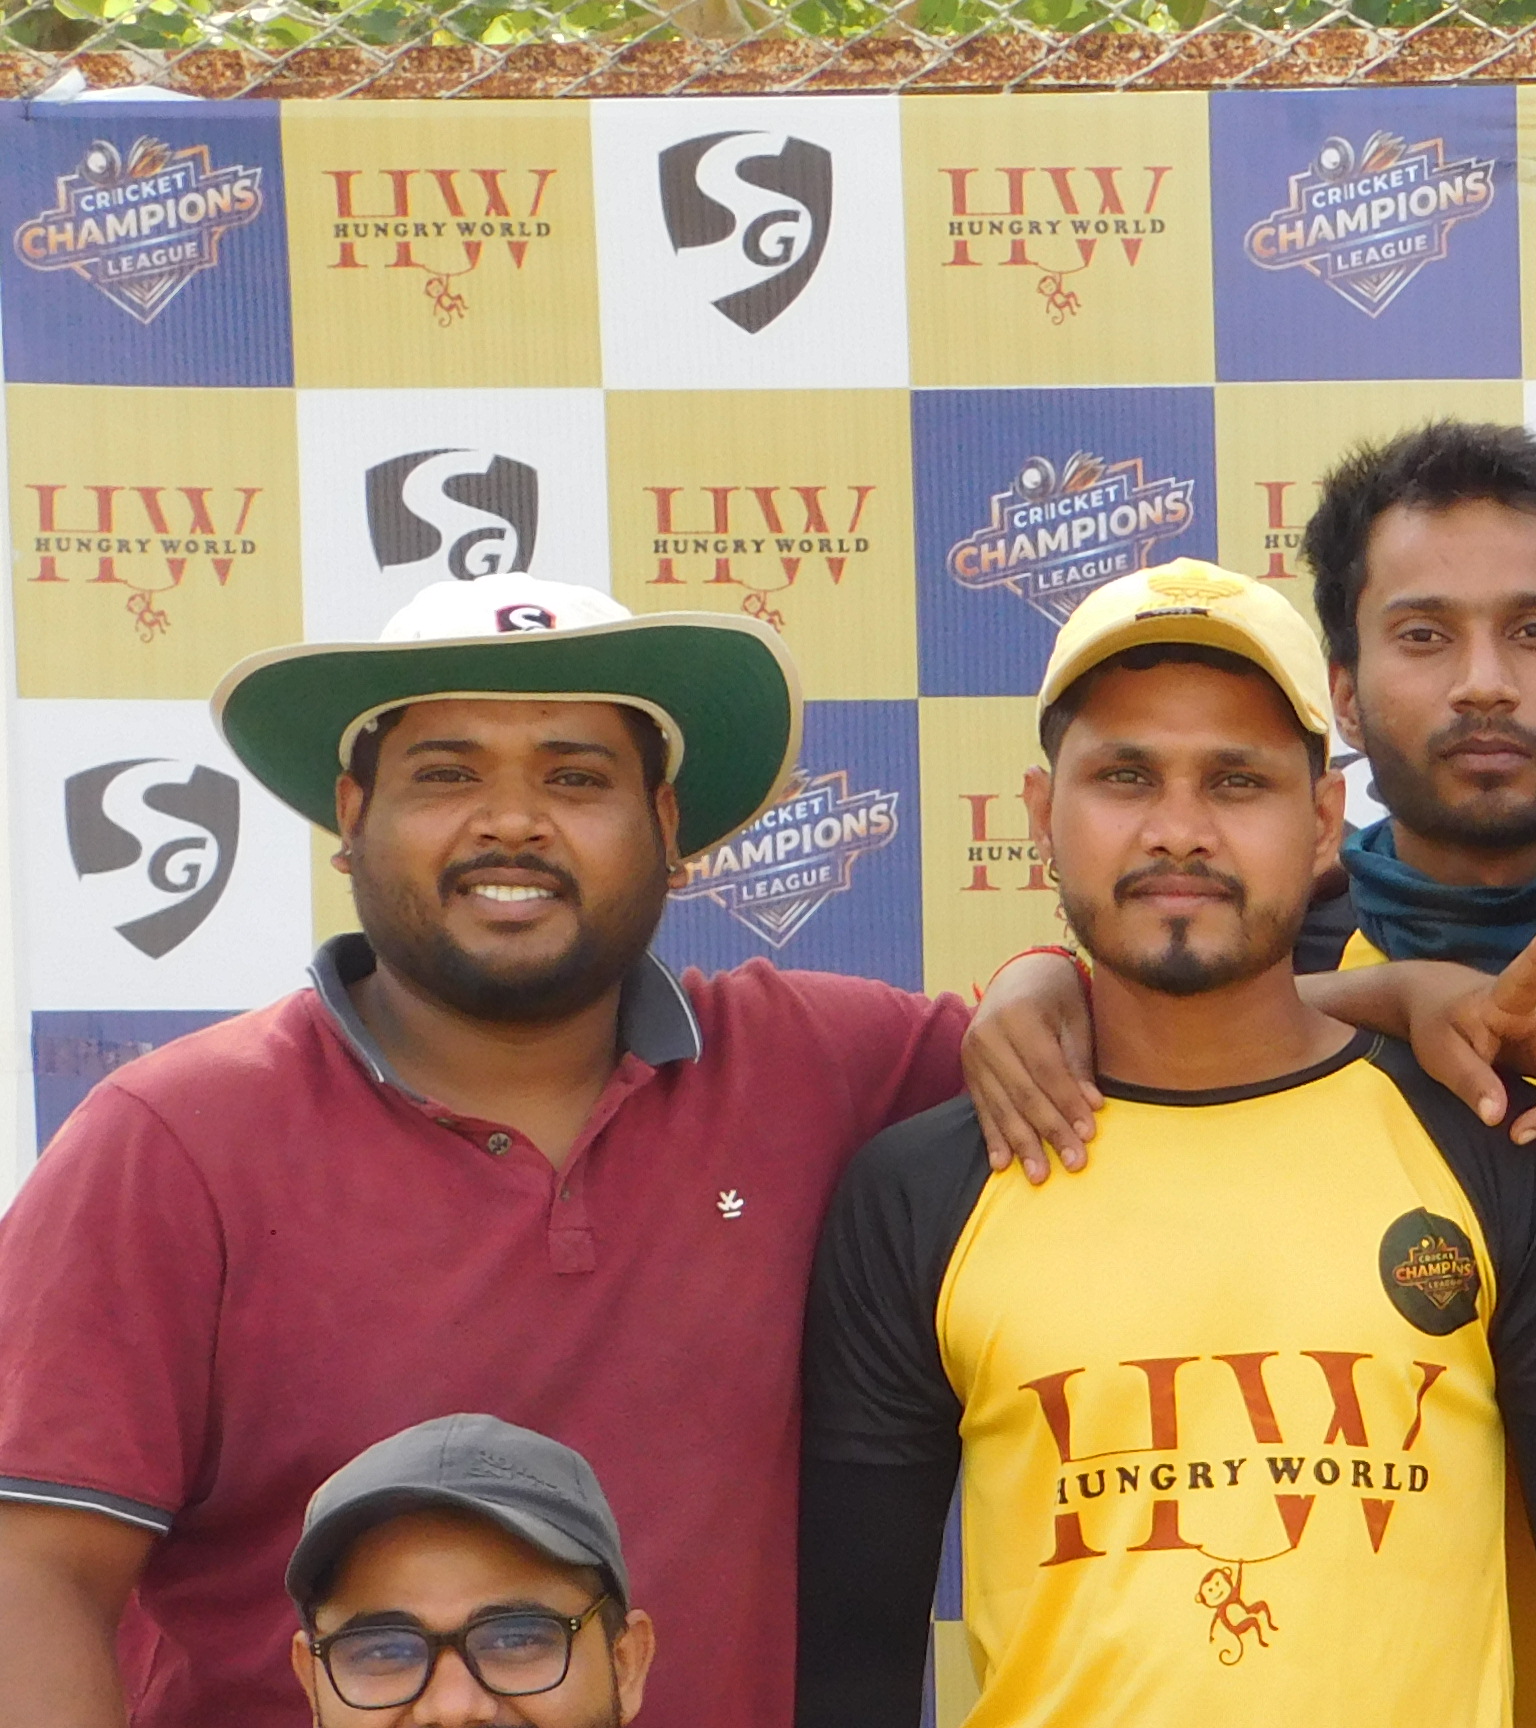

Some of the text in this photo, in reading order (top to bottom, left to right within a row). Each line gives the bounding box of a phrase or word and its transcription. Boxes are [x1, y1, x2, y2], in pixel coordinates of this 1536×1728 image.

[22, 179, 256, 259] CHAMPIONS
[322, 168, 557, 269] HW
[333, 220, 551, 238] HUNGRY WORLD
[938, 166, 1173, 267] HW
[948, 218, 1165, 237] HUNGRY WORLD
[1250, 170, 1488, 256] CHAMPIONS
[107, 241, 198, 276] LEAGUE
[1336, 234, 1428, 270] LEAGUE
[25, 484, 264, 583] HW
[35, 538, 256, 555] HUNGRY WORLD
[643, 485, 877, 584] HW
[653, 537, 870, 554] HUNGRY WORLD
[954, 489, 1189, 578] CHAMPIONS
[1038, 553, 1128, 590] LEAGUE
[750, 795, 823, 834] CKET
[686, 803, 891, 884] HAMPIONS
[969, 846, 1039, 862] HUNG
[742, 865, 832, 901] LEAGUE
[1018, 1350, 1447, 1567] HW
[1055, 1456, 1429, 1504] HUNGRY WORLD
